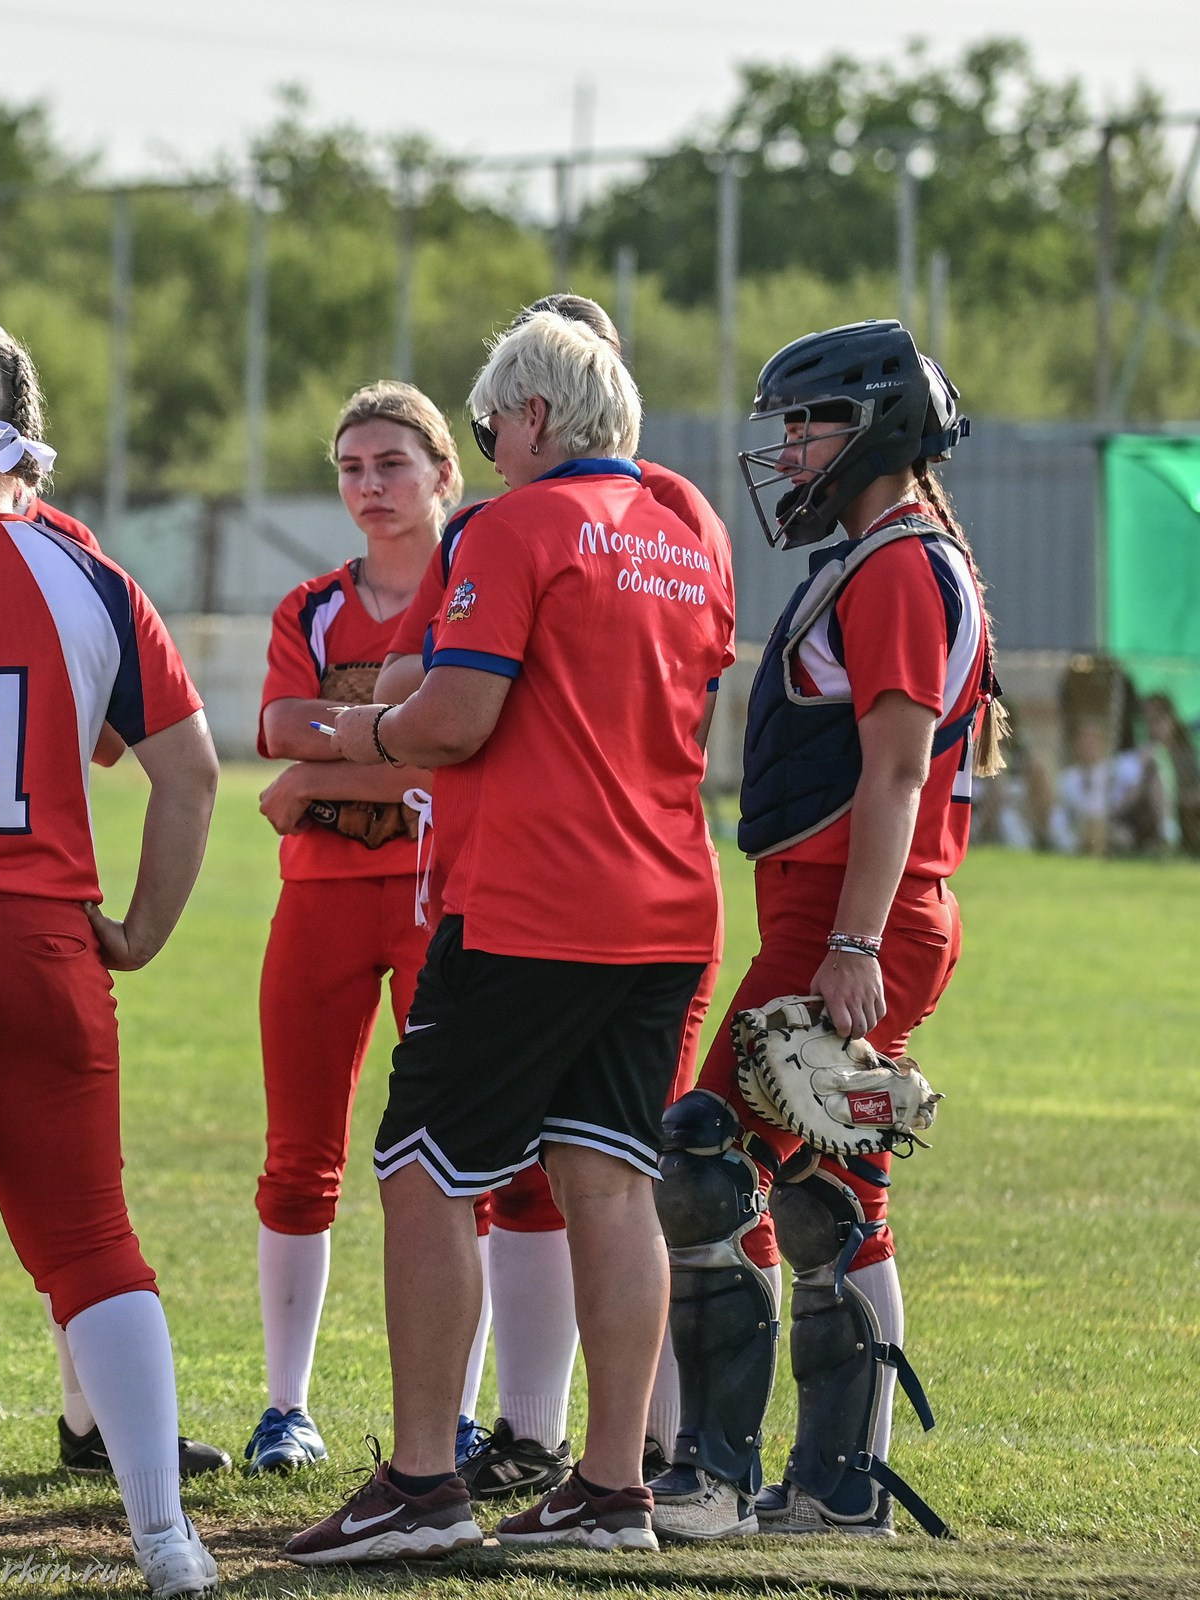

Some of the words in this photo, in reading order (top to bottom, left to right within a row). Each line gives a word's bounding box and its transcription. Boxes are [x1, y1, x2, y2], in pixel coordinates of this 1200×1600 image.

[578, 521, 712, 574] Московская
[616, 555, 707, 606] область
[853, 1099, 887, 1115] Rawlings
